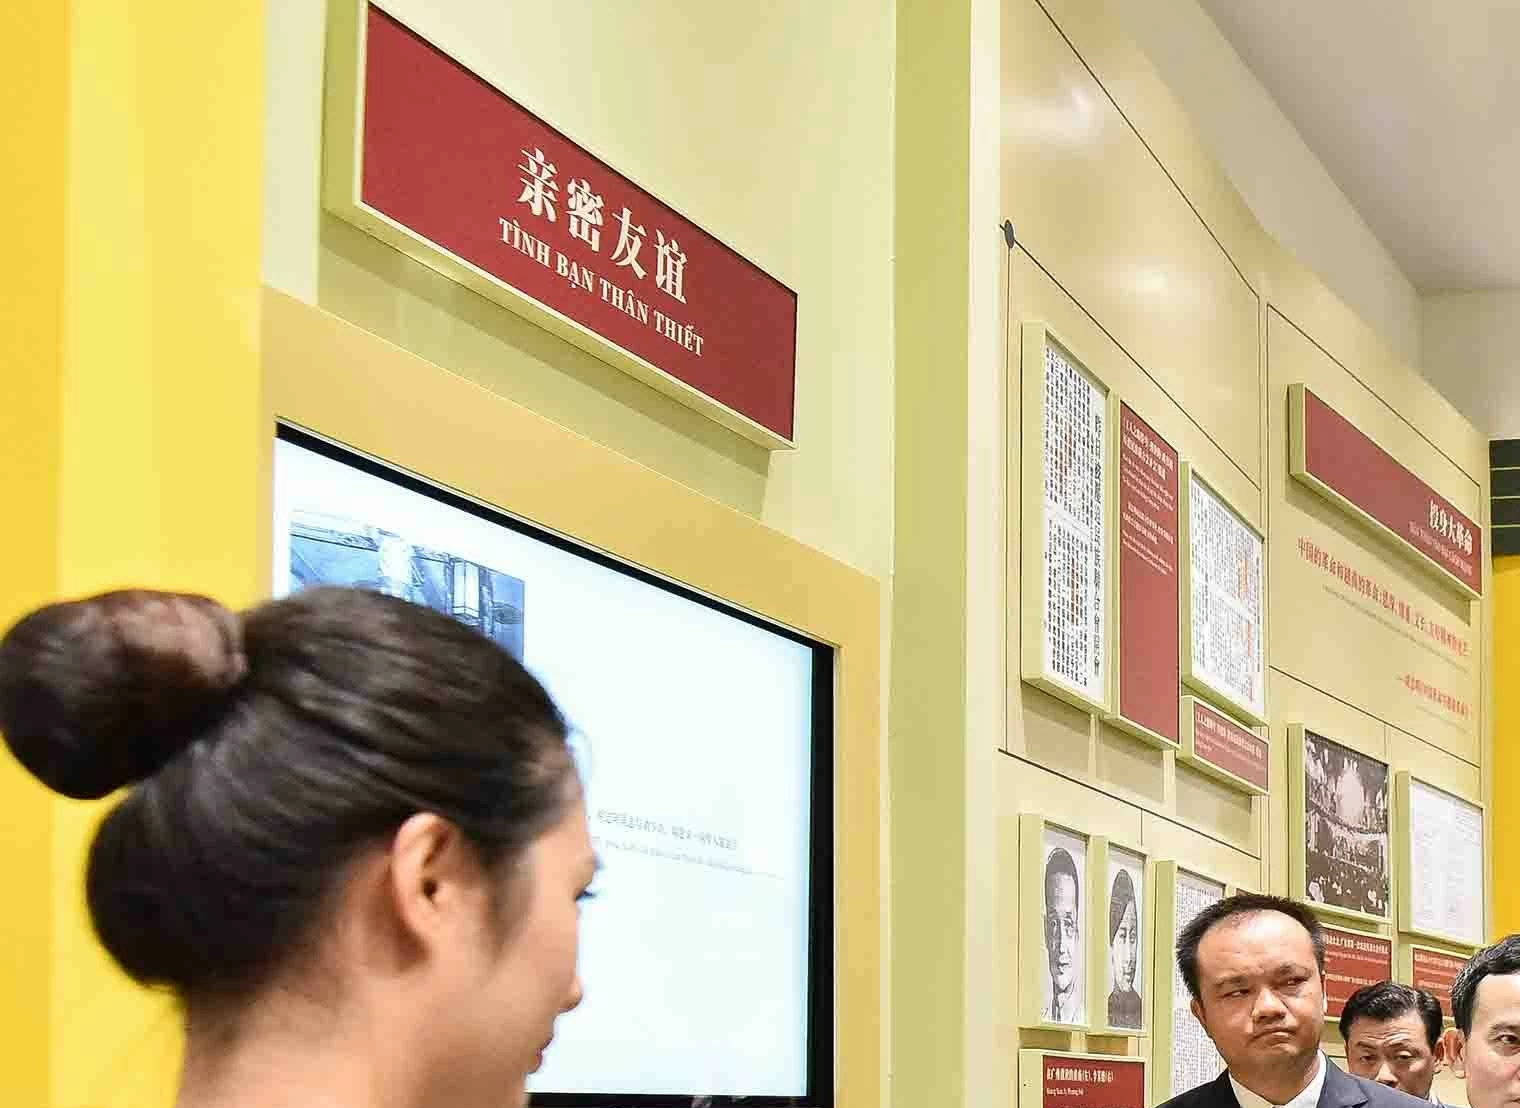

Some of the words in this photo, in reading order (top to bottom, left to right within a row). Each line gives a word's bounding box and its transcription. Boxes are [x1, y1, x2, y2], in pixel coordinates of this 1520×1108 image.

[499, 217, 551, 269] TÌNH
[555, 251, 595, 293] BẠN
[599, 277, 650, 325] THÂN
[653, 309, 704, 357] THIẾT
[516, 147, 688, 304] 亲密友谊
